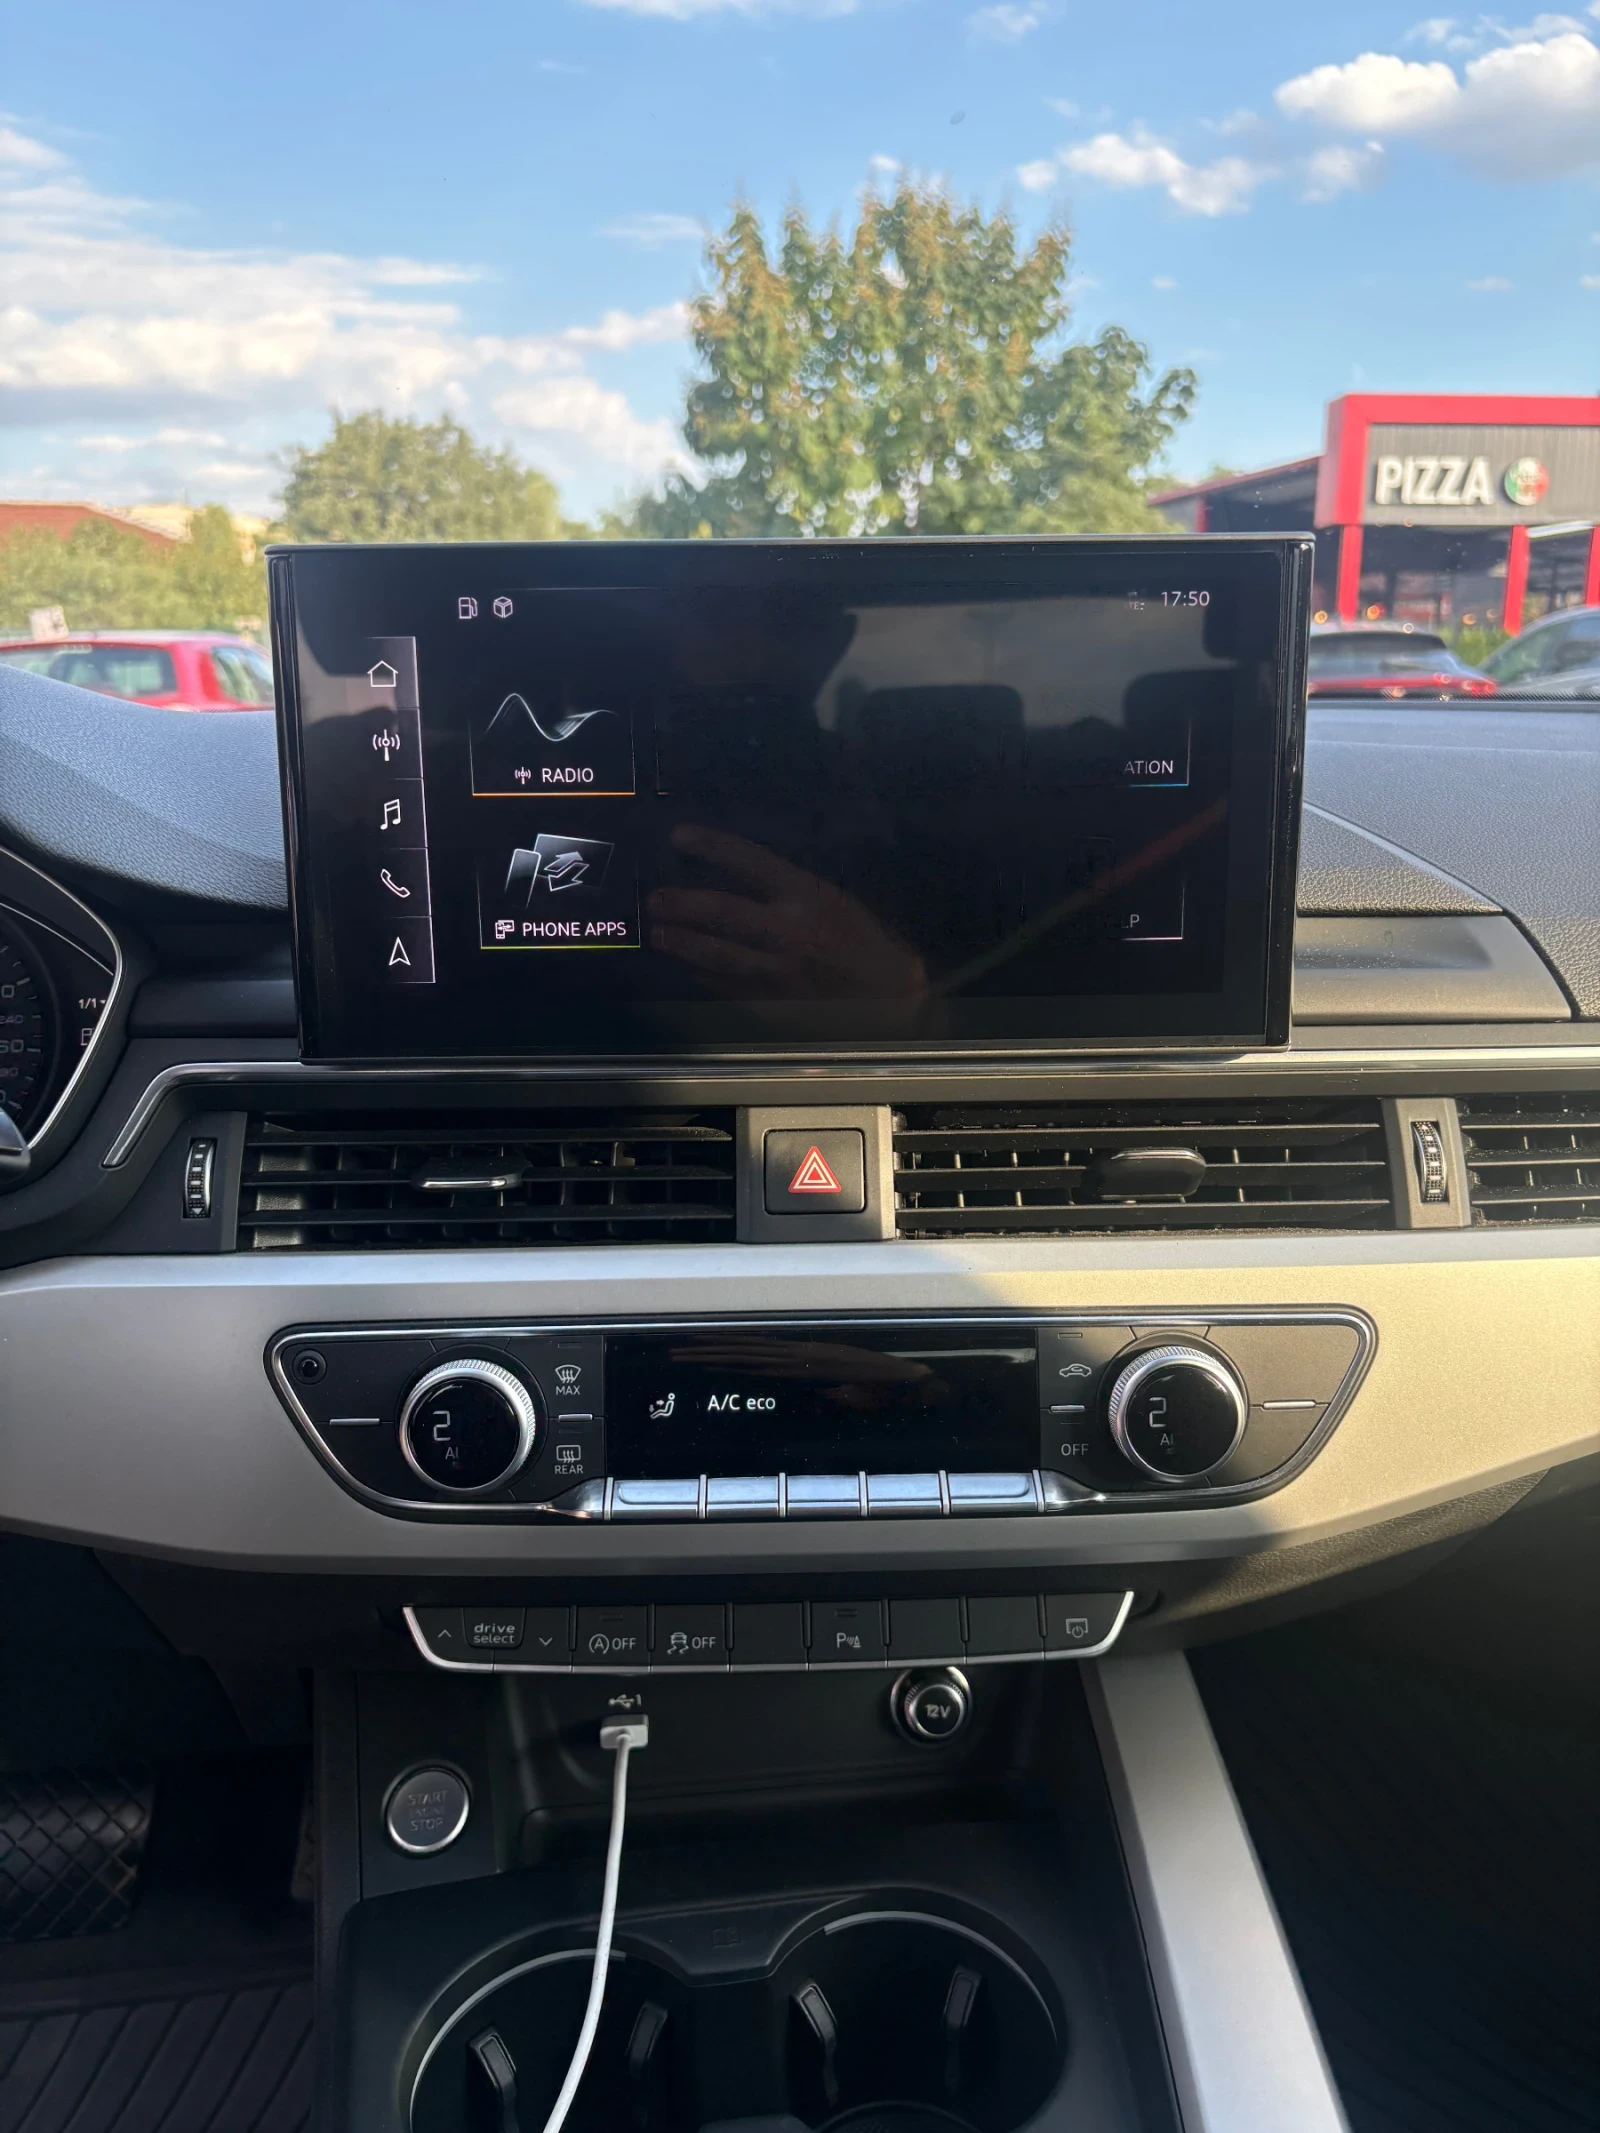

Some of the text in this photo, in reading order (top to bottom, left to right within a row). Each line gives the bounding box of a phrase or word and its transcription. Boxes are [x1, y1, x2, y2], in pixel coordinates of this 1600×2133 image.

[1375, 455, 1494, 505] PIZZA
[1161, 591, 1210, 606] 17:50
[541, 768, 594, 783] RADIO
[522, 922, 627, 936] PHONE APPS
[555, 1385, 581, 1396] MAX
[707, 1394, 776, 1411] A/C eco
[1060, 1443, 1089, 1456] OFF
[554, 1464, 584, 1475] REAR
[473, 1622, 516, 1634] drive
[473, 1633, 515, 1645] select
[611, 1637, 637, 1650] OFF
[691, 1636, 717, 1649] OFF
[925, 1703, 951, 1718] 12V
[407, 1790, 449, 1806] START
[410, 1817, 444, 1831] STOP
